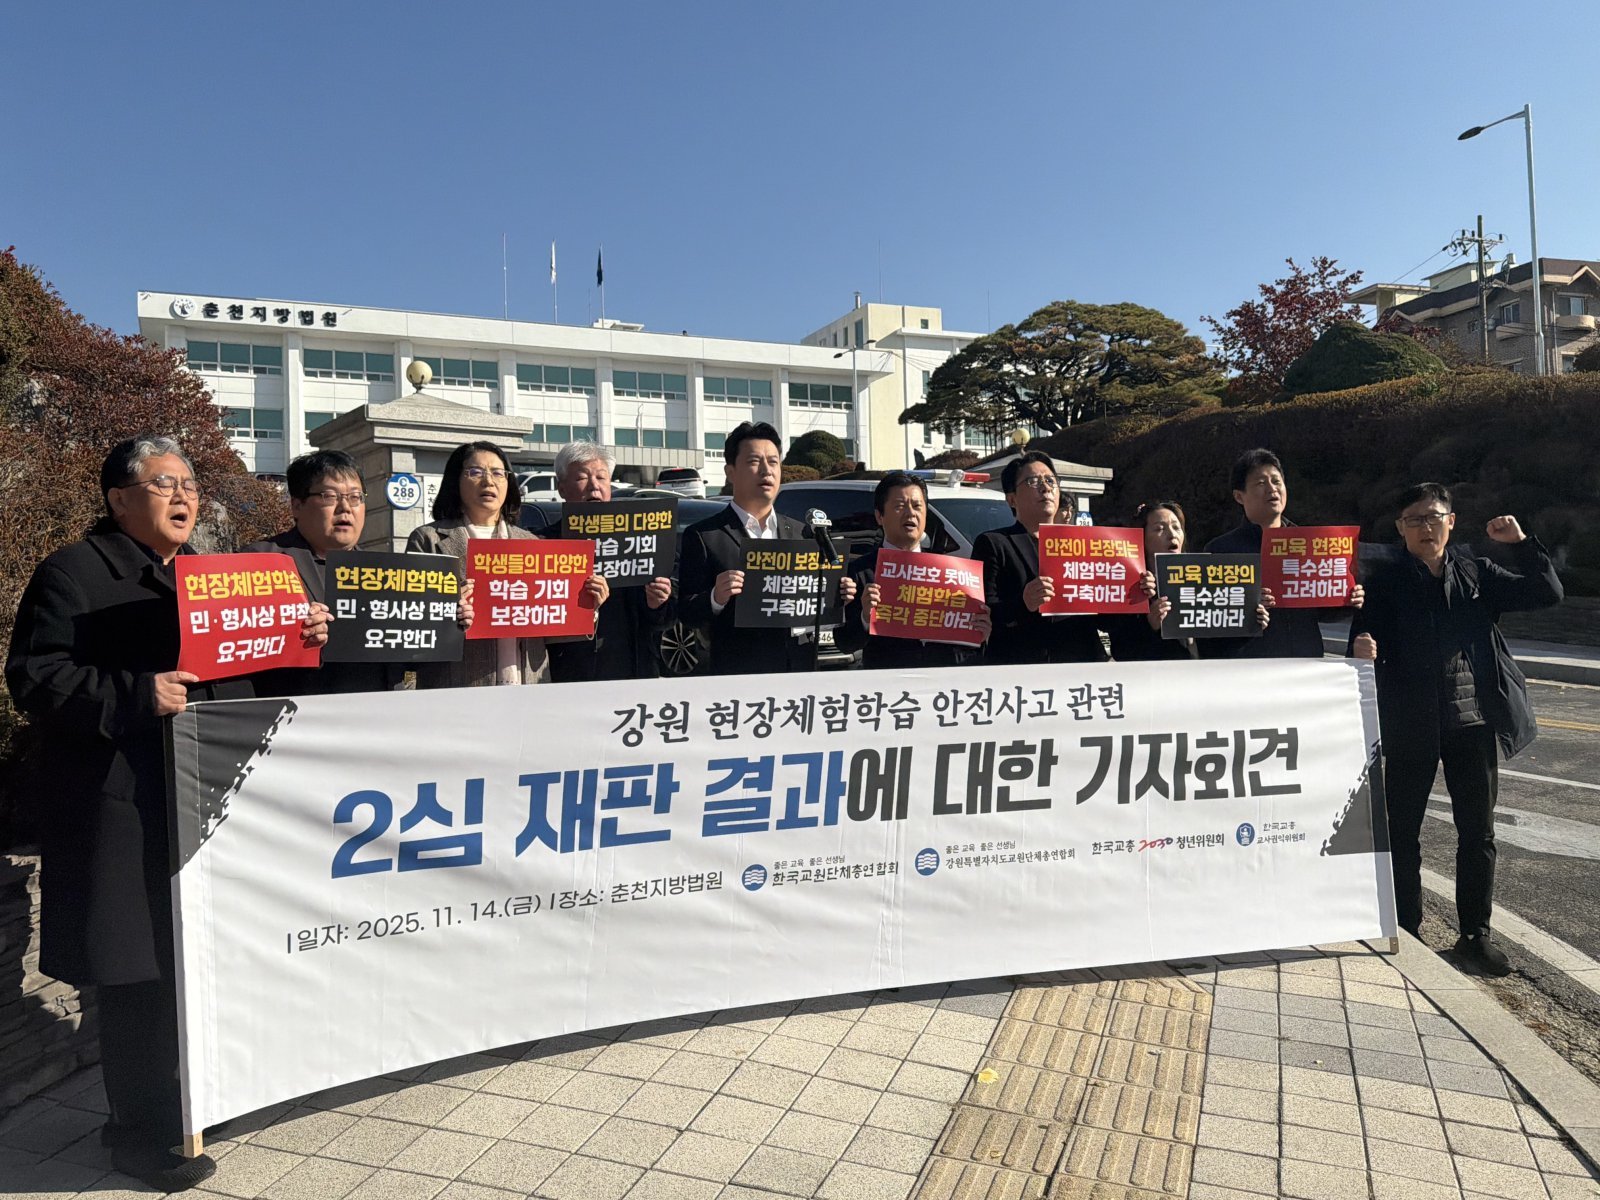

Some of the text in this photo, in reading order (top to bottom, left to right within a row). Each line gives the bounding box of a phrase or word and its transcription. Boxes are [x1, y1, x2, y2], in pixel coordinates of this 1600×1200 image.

[202, 302, 337, 327] 춘천지방법원
[393, 487, 414, 498] 288
[568, 510, 672, 534] 학생들의 다양한
[624, 534, 656, 554] 기회
[1046, 538, 1139, 558] 안전이 보장되는
[1270, 536, 1354, 556] 교육 현장의
[474, 554, 588, 574] 학생들의 다양한
[746, 552, 791, 570] 안전이
[1062, 562, 1126, 580] 체험학습
[1282, 558, 1347, 577] 특수성을
[335, 566, 458, 594] 현장체험학습
[881, 562, 980, 588] 교사보호 못하는
[1166, 565, 1254, 584] 교육 현장의
[184, 570, 304, 600] 현장체험학습
[489, 579, 568, 600] 학습 기회
[1062, 584, 1126, 602] 구축하라
[1282, 579, 1348, 598] 고려하라
[897, 584, 966, 608] 체험학습
[1180, 586, 1245, 606] 특수성을
[430, 602, 457, 621] 면책
[491, 604, 567, 626] 보장하라
[876, 604, 910, 626] 즉각
[1179, 609, 1244, 628] 고려하라
[364, 629, 436, 648] 요구한다
[216, 635, 286, 664] 요구한다
[612, 682, 1126, 747] 강원 현장체험학습 안전사고 관련
[331, 727, 1302, 878] 2심 재판 결과에 대한 기자회견
[946, 840, 1016, 854] 좋은 교육 좋은 선생님
[1092, 840, 1135, 855] 한국교총
[1176, 833, 1224, 850] 청년위원회
[774, 855, 846, 870] 좋은 교육 좋은 선생님
[772, 861, 899, 886] 한국교원단체총연합회
[357, 912, 424, 940] 2025.
[433, 906, 462, 928] 11.
[470, 894, 541, 921] 14.(금)
[610, 871, 723, 903] 춘천지방법원
